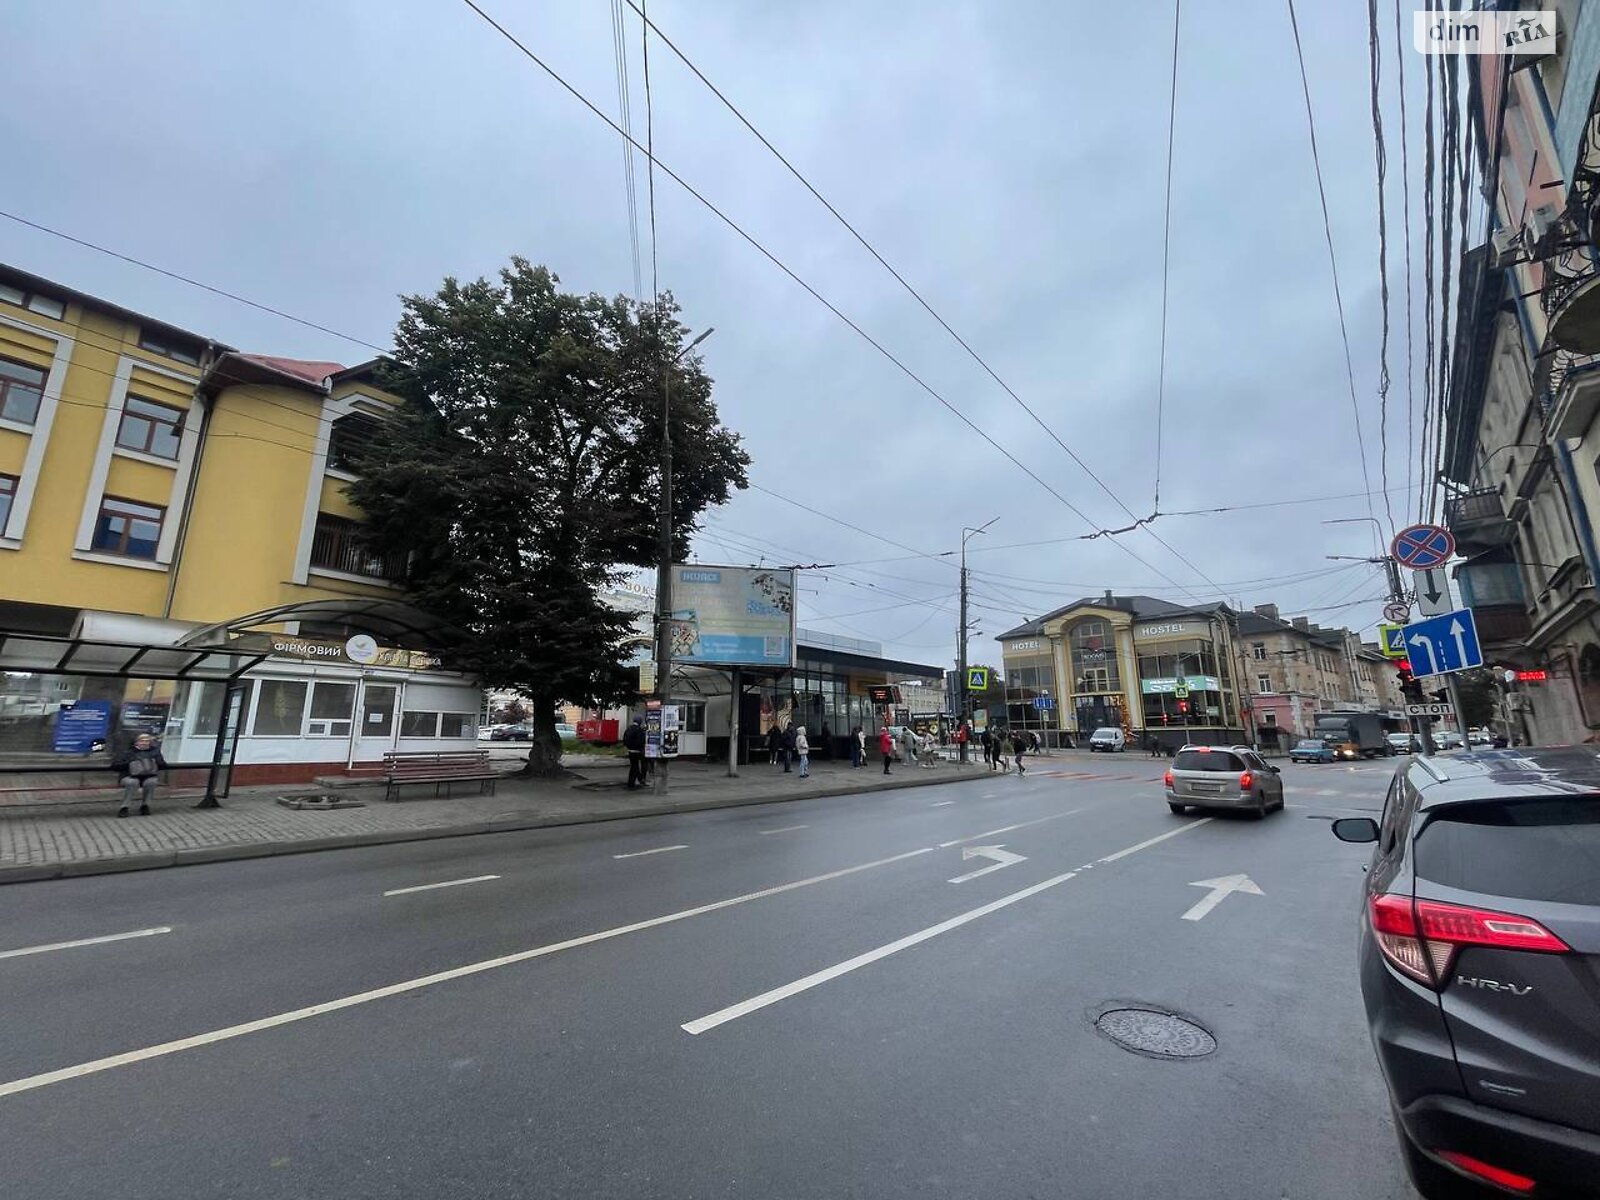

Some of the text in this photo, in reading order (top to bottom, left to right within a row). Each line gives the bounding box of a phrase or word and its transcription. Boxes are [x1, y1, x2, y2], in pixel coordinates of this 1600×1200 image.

[1142, 623, 1186, 636] HOSTEL
[274, 643, 341, 657] ФІРМОВИЙ
[1012, 640, 1041, 650] HOTEL
[1409, 704, 1449, 714] СТОП
[1457, 975, 1533, 996] HR-V
